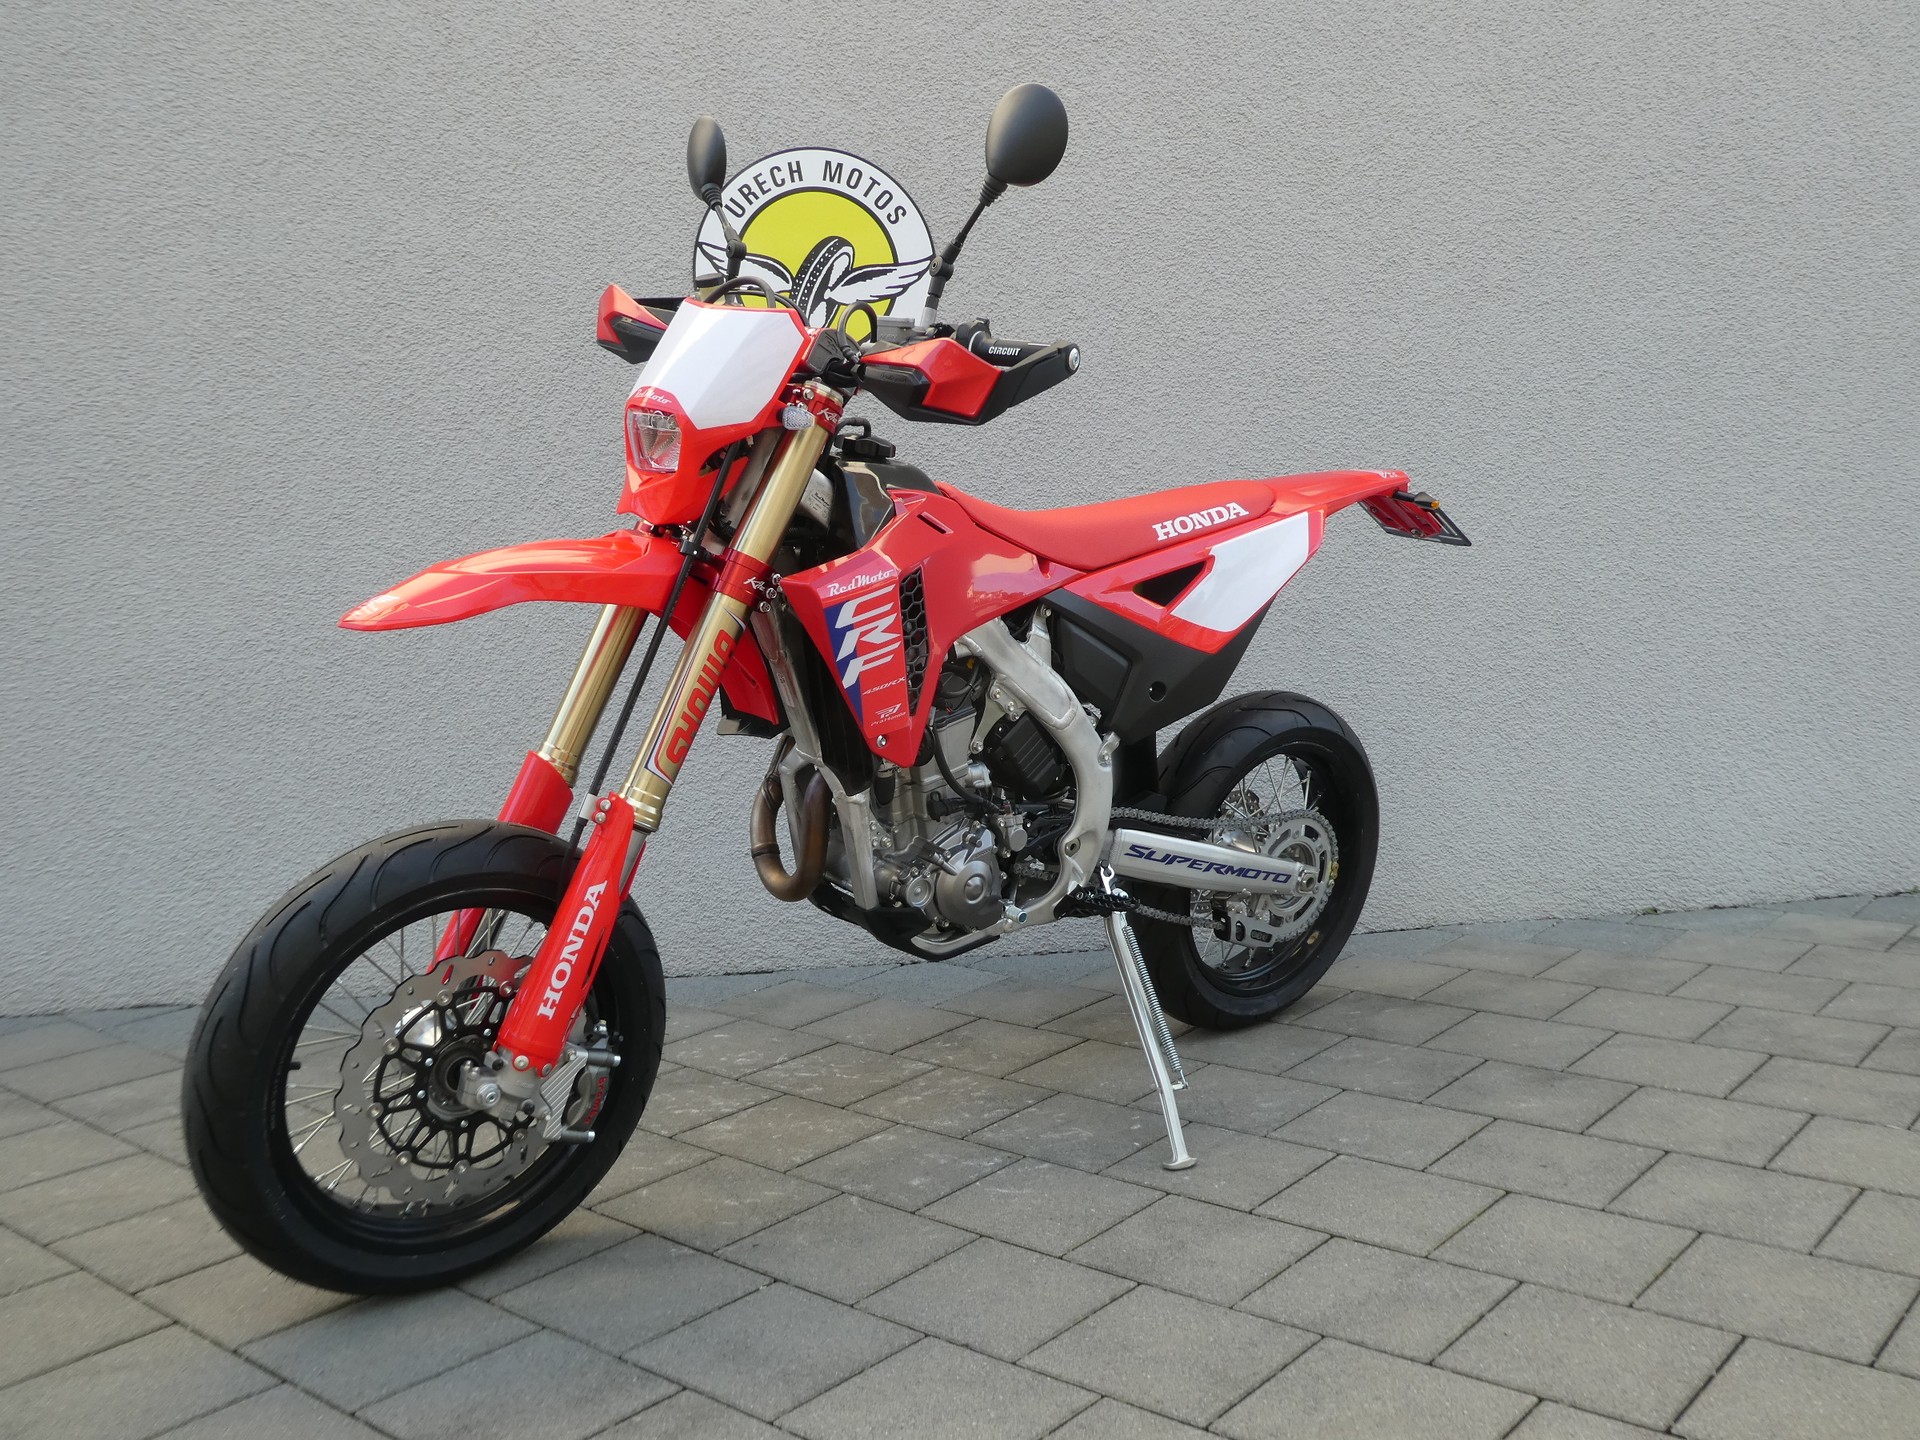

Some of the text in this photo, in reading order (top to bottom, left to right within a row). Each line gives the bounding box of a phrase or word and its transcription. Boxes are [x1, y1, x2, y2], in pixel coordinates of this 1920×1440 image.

[724, 160, 907, 225] URECH MOTOS
[988, 345, 1021, 356] CIRCUIT
[1152, 502, 1249, 541] HONDA
[834, 584, 903, 689] CRF
[666, 629, 736, 764] SHOWA
[1124, 844, 1292, 884] SUPERMOTO
[537, 880, 608, 1020] HONDA
